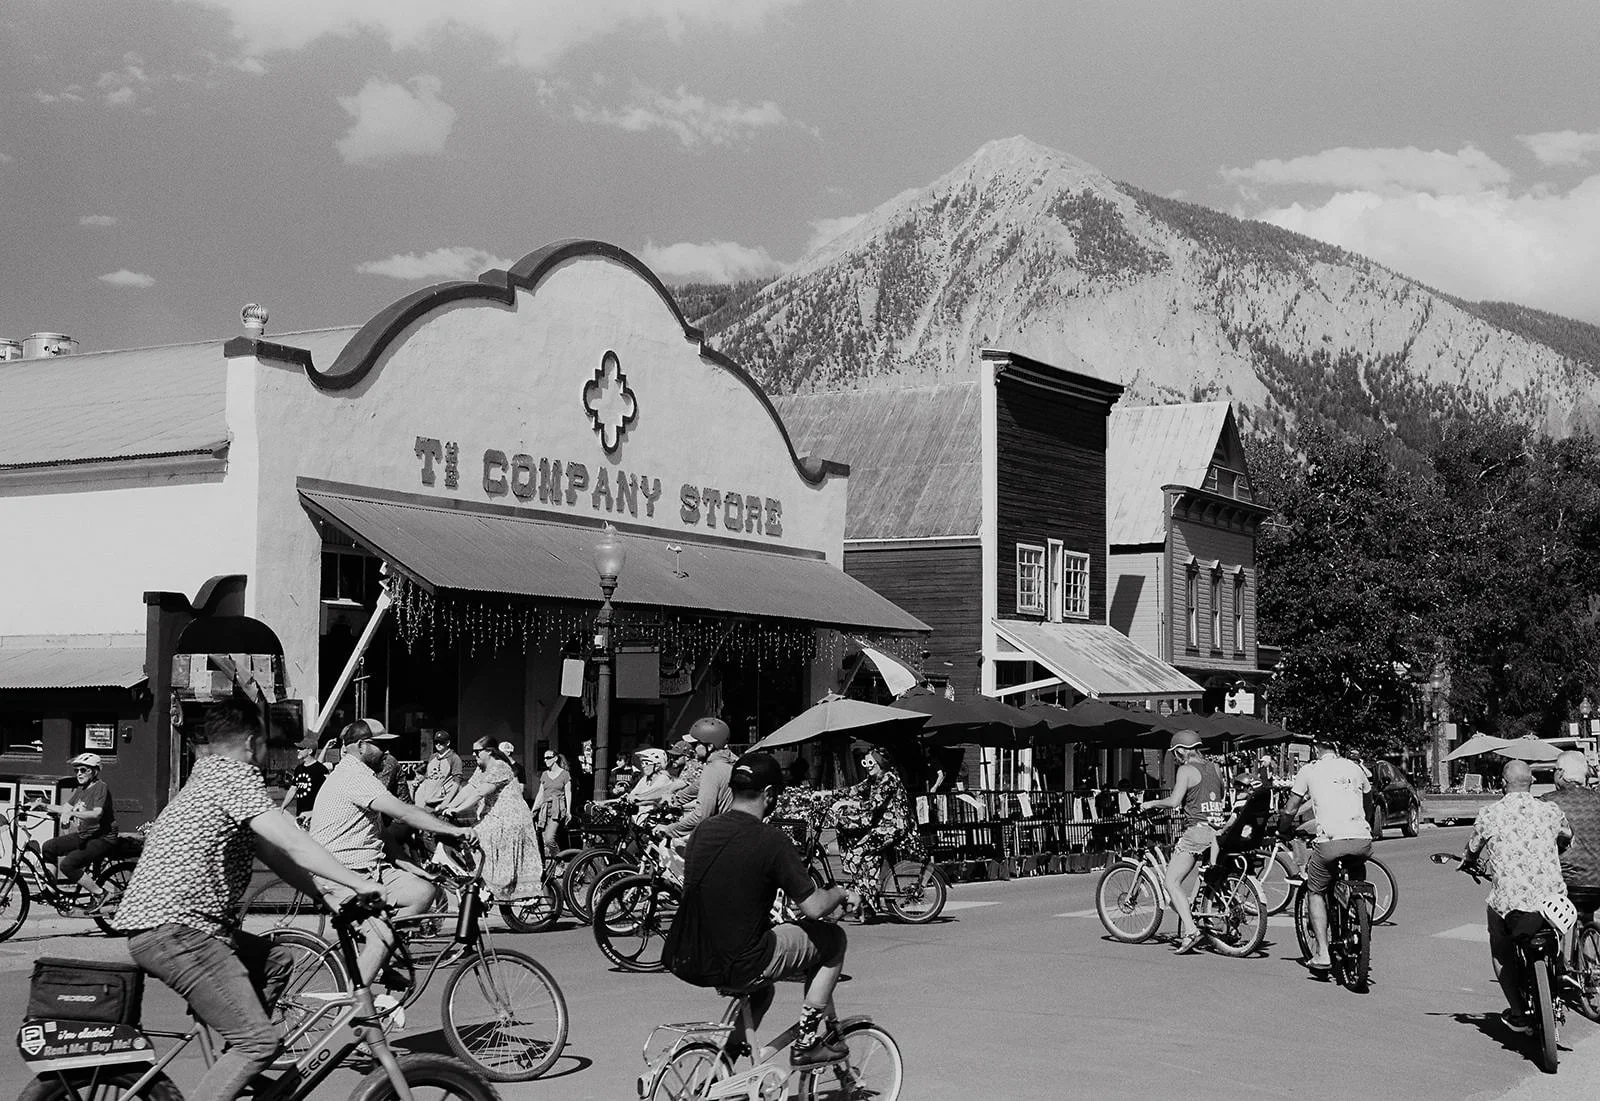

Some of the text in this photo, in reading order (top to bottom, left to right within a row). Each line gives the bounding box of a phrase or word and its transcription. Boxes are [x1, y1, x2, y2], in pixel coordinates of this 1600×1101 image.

[483, 449, 662, 518] COMPANY
[680, 483, 783, 538] STORE
[43, 1038, 133, 1057] Rent Me! Buy Me!
